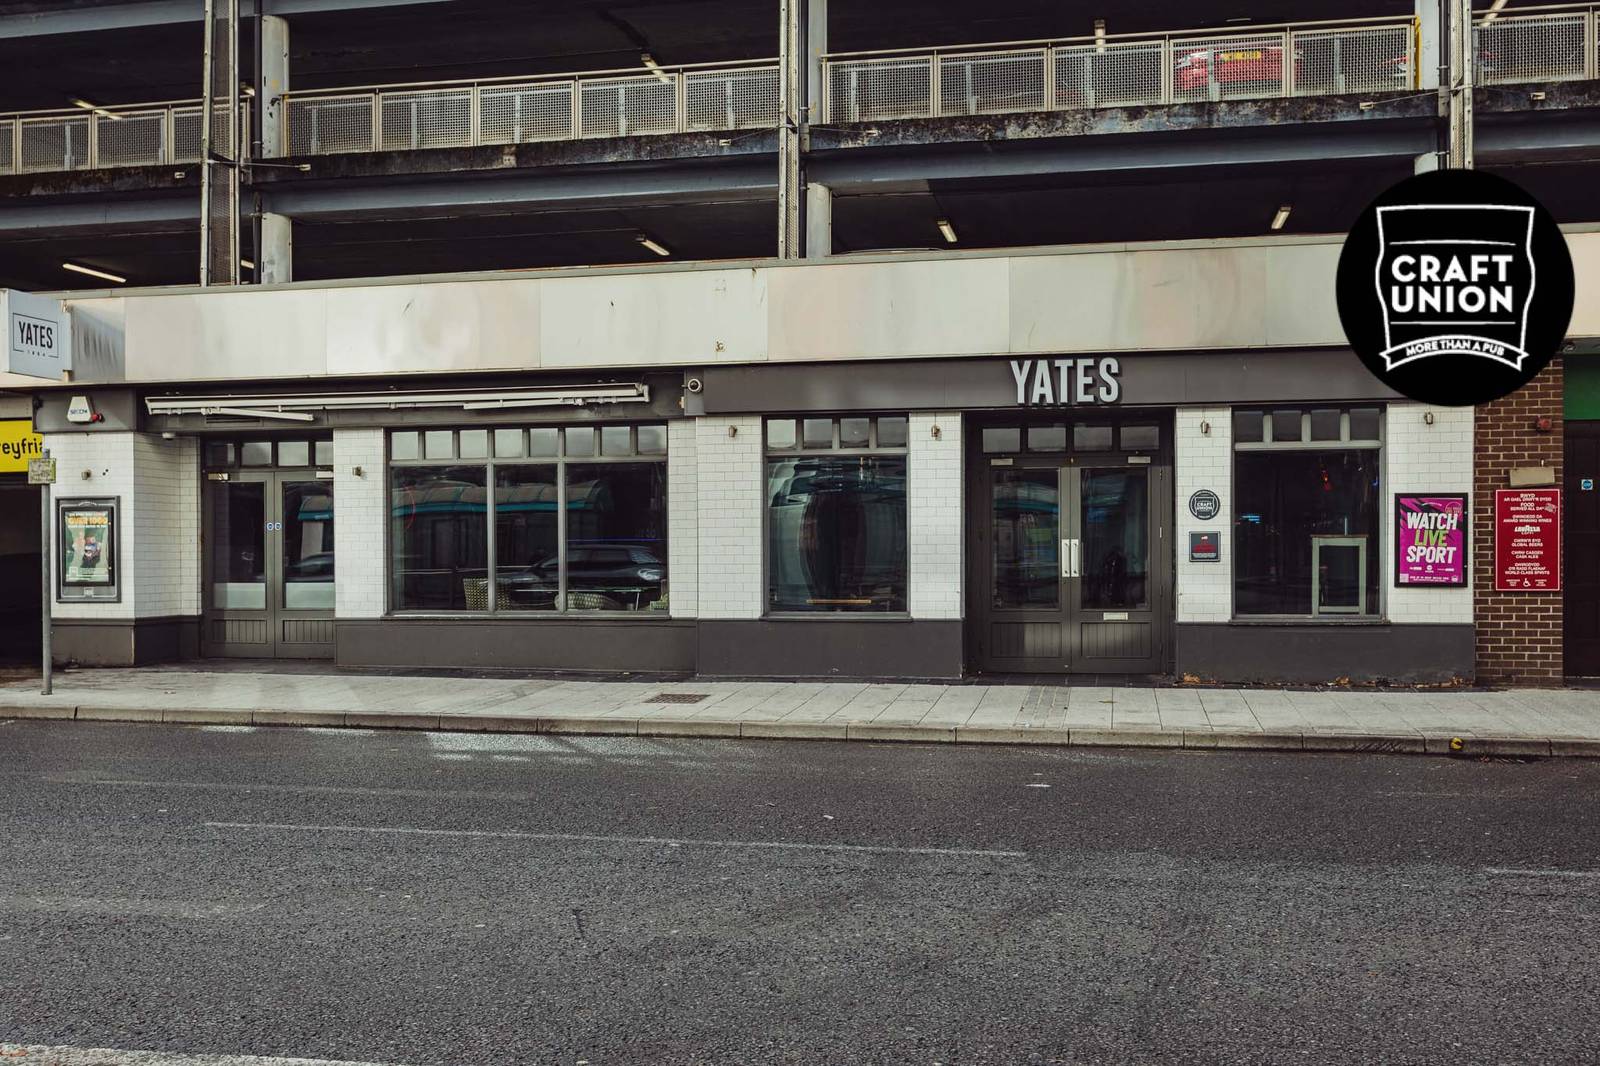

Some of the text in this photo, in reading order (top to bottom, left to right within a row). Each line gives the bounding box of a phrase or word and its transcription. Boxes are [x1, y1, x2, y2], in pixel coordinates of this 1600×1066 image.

[18, 321, 53, 349] YATES
[1010, 357, 1119, 404] YATES
[0, 437, 43, 459] eyfri
[1407, 511, 1458, 530] WATCH
[1415, 530, 1449, 547] LIVE
[1406, 546, 1457, 564] SPORT
